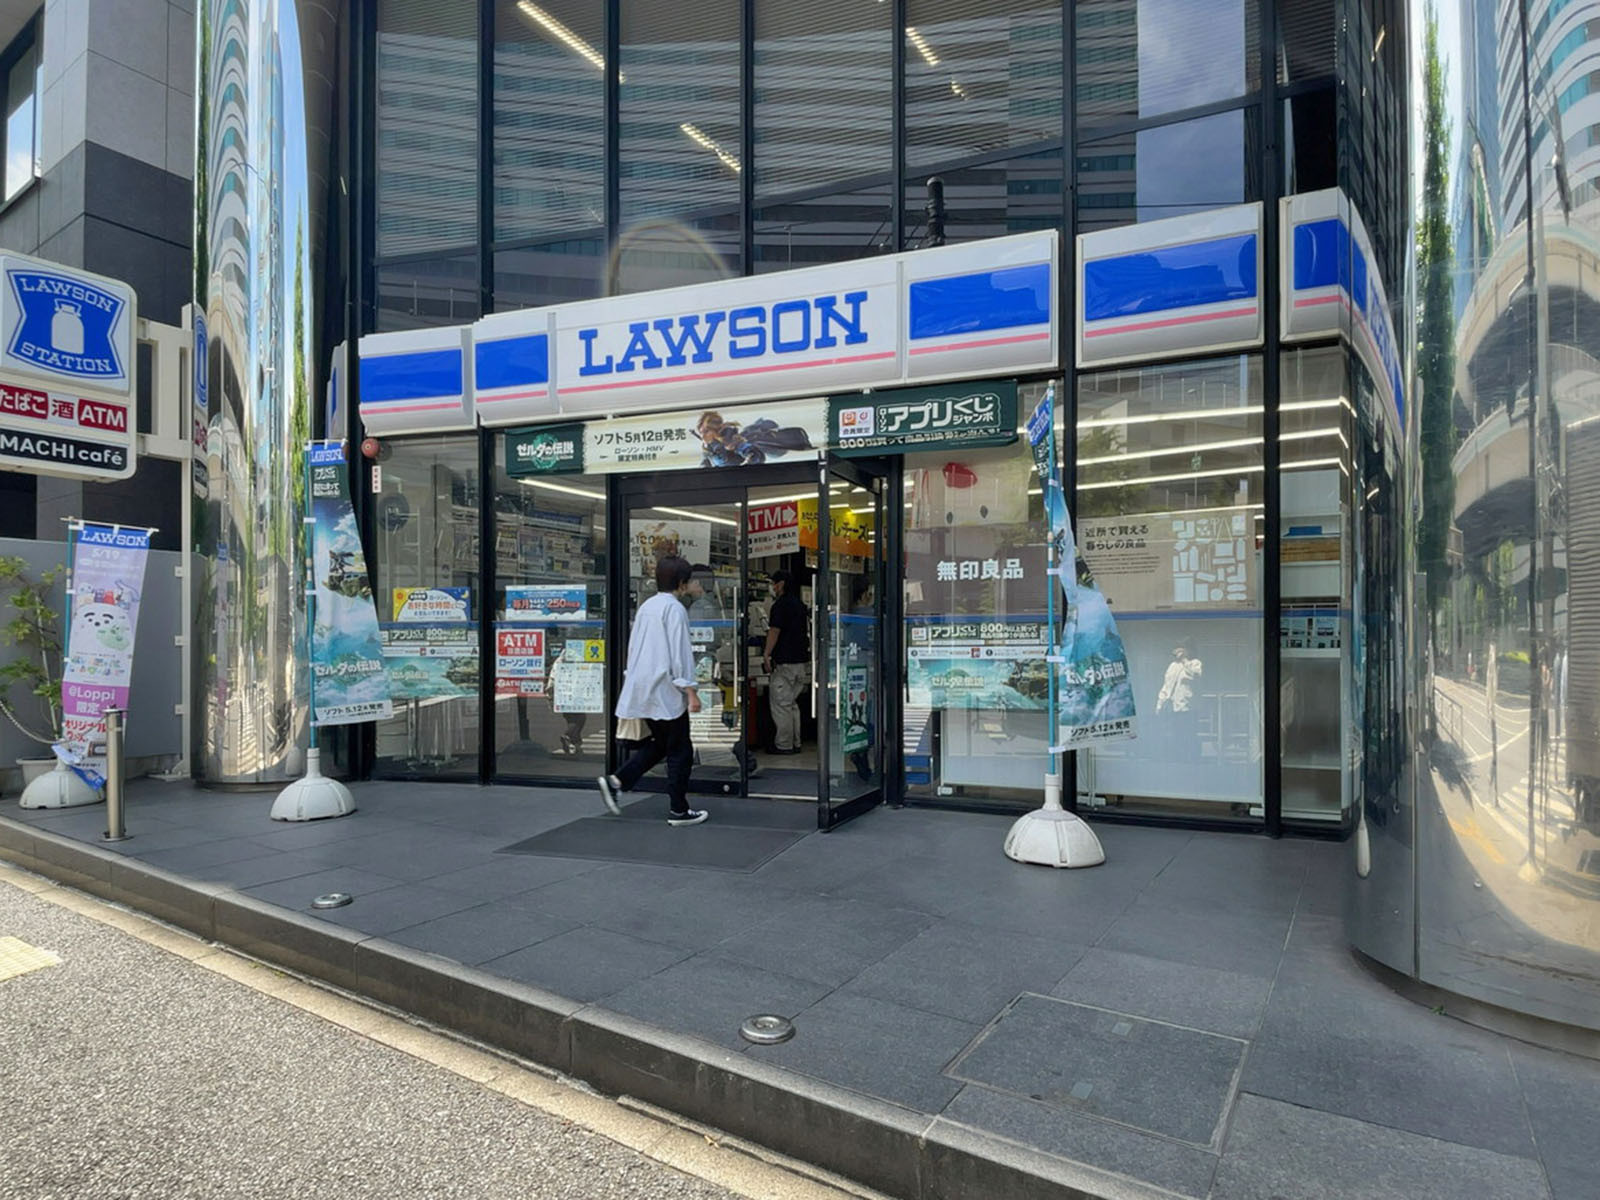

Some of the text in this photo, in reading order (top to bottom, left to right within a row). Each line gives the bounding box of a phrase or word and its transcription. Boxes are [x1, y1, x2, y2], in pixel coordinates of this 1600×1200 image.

[19, 277, 114, 313] LAWSON
[578, 290, 868, 377] LAWSON
[21, 341, 112, 373] STATION
[0, 389, 46, 414] たばこ
[51, 398, 75, 420] 酒
[80, 405, 124, 427] ATM
[888, 396, 994, 432] アプリくじ
[953, 411, 994, 425] ジャンボ
[594, 428, 687, 445] ソフト5月12日発売
[0, 434, 123, 465] MACHI café
[312, 448, 343, 462] LAWSON
[516, 441, 574, 457] ゼルダの伝説
[81, 530, 147, 546] LAWSON
[1085, 524, 1149, 538] 近所で買える
[1086, 538, 1146, 551] 暮らしの良品
[937, 558, 1024, 581] 無印良品
[503, 633, 537, 647] ATM
[314, 660, 382, 676] ゼルダの伝説
[499, 658, 542, 667] ローソン銀行
[1064, 662, 1126, 686] ゼルダの伝説
